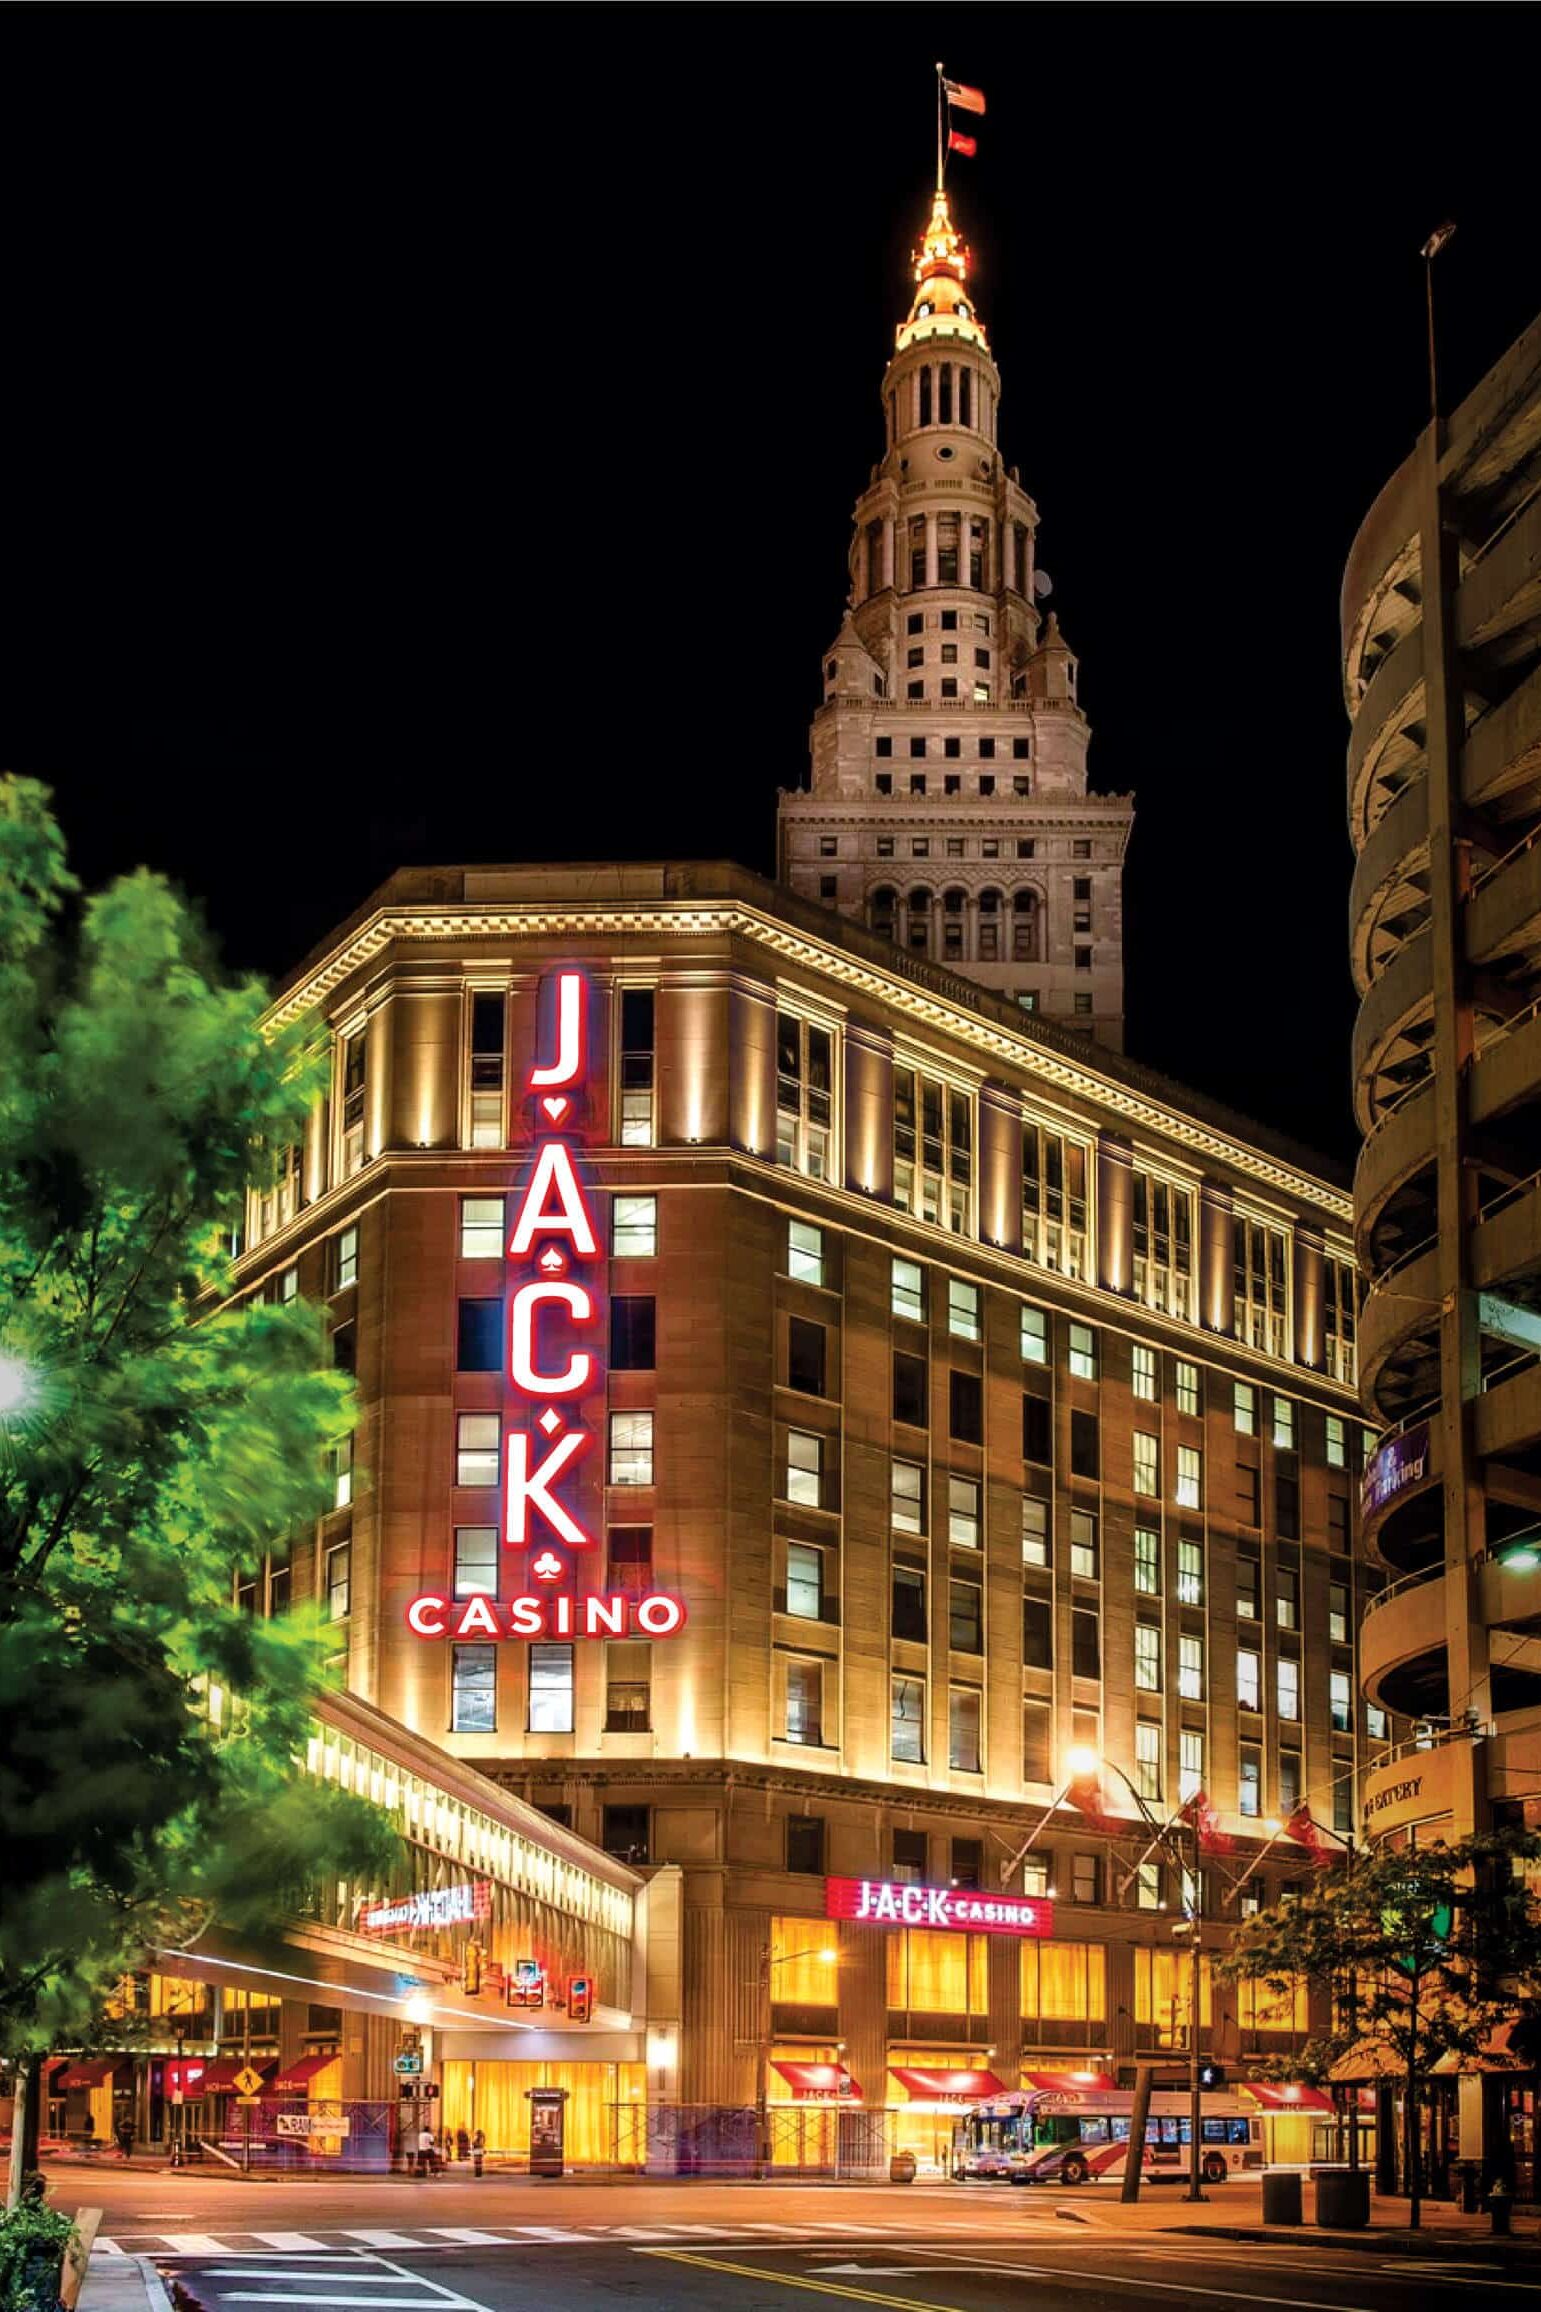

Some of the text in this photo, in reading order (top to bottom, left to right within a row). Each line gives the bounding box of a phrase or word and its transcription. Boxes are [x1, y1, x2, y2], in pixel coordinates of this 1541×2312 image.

[505, 974, 597, 1543] JACK
[408, 1596, 681, 1634] CASINO
[856, 1880, 1035, 1925] JACK CASINO
